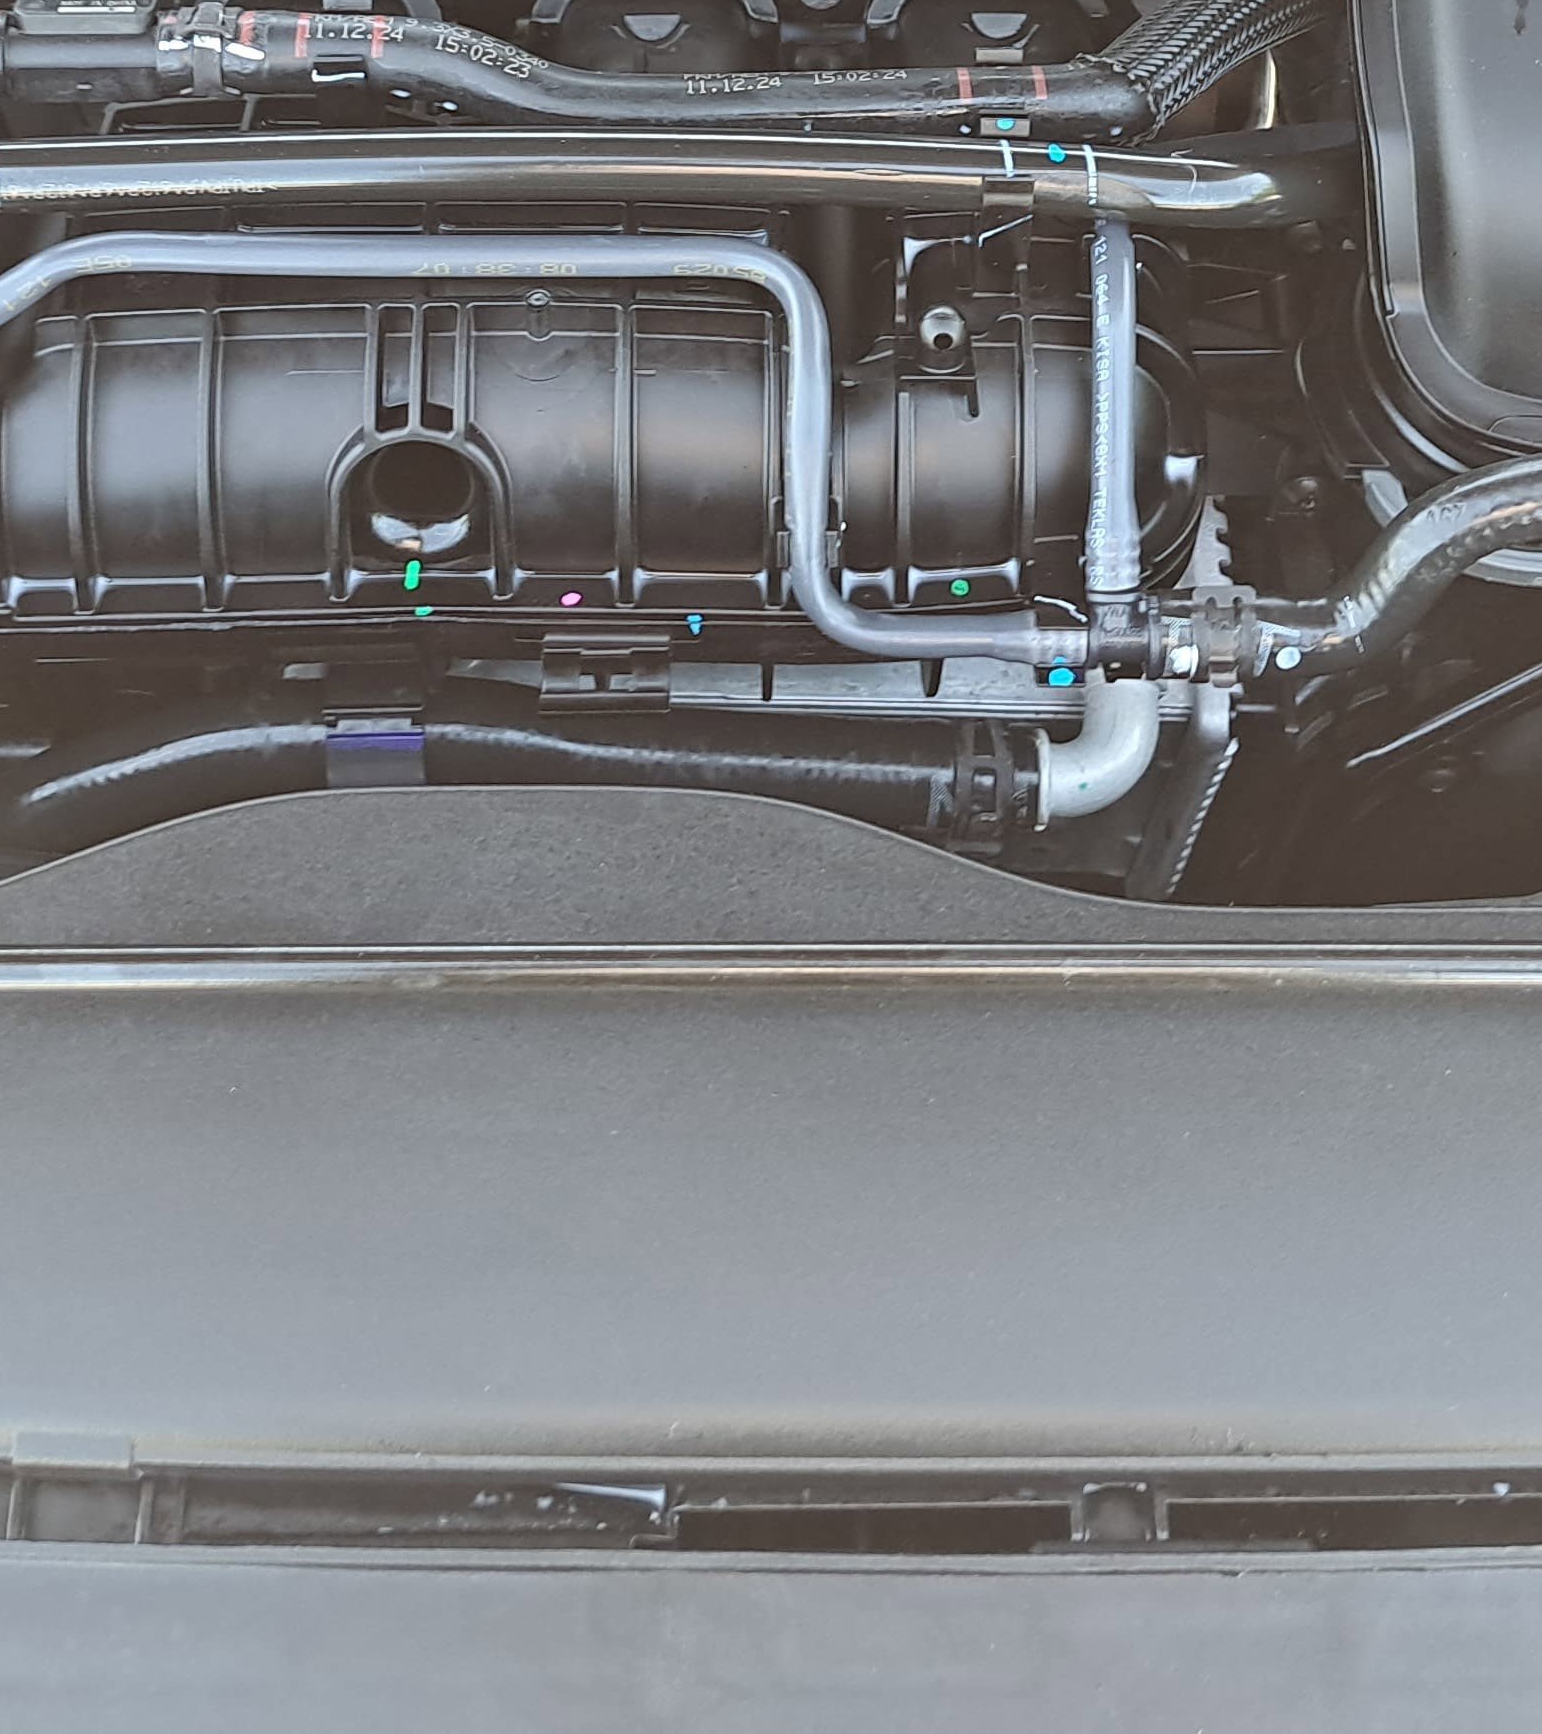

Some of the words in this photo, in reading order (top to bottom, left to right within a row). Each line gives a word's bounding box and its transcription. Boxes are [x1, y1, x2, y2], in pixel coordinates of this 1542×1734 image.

[434, 34, 533, 79] 15:02:23
[685, 75, 783, 95] 11.12.24
[1093, 234, 1109, 265] 121
[1090, 488, 1108, 550] TEKLAS
